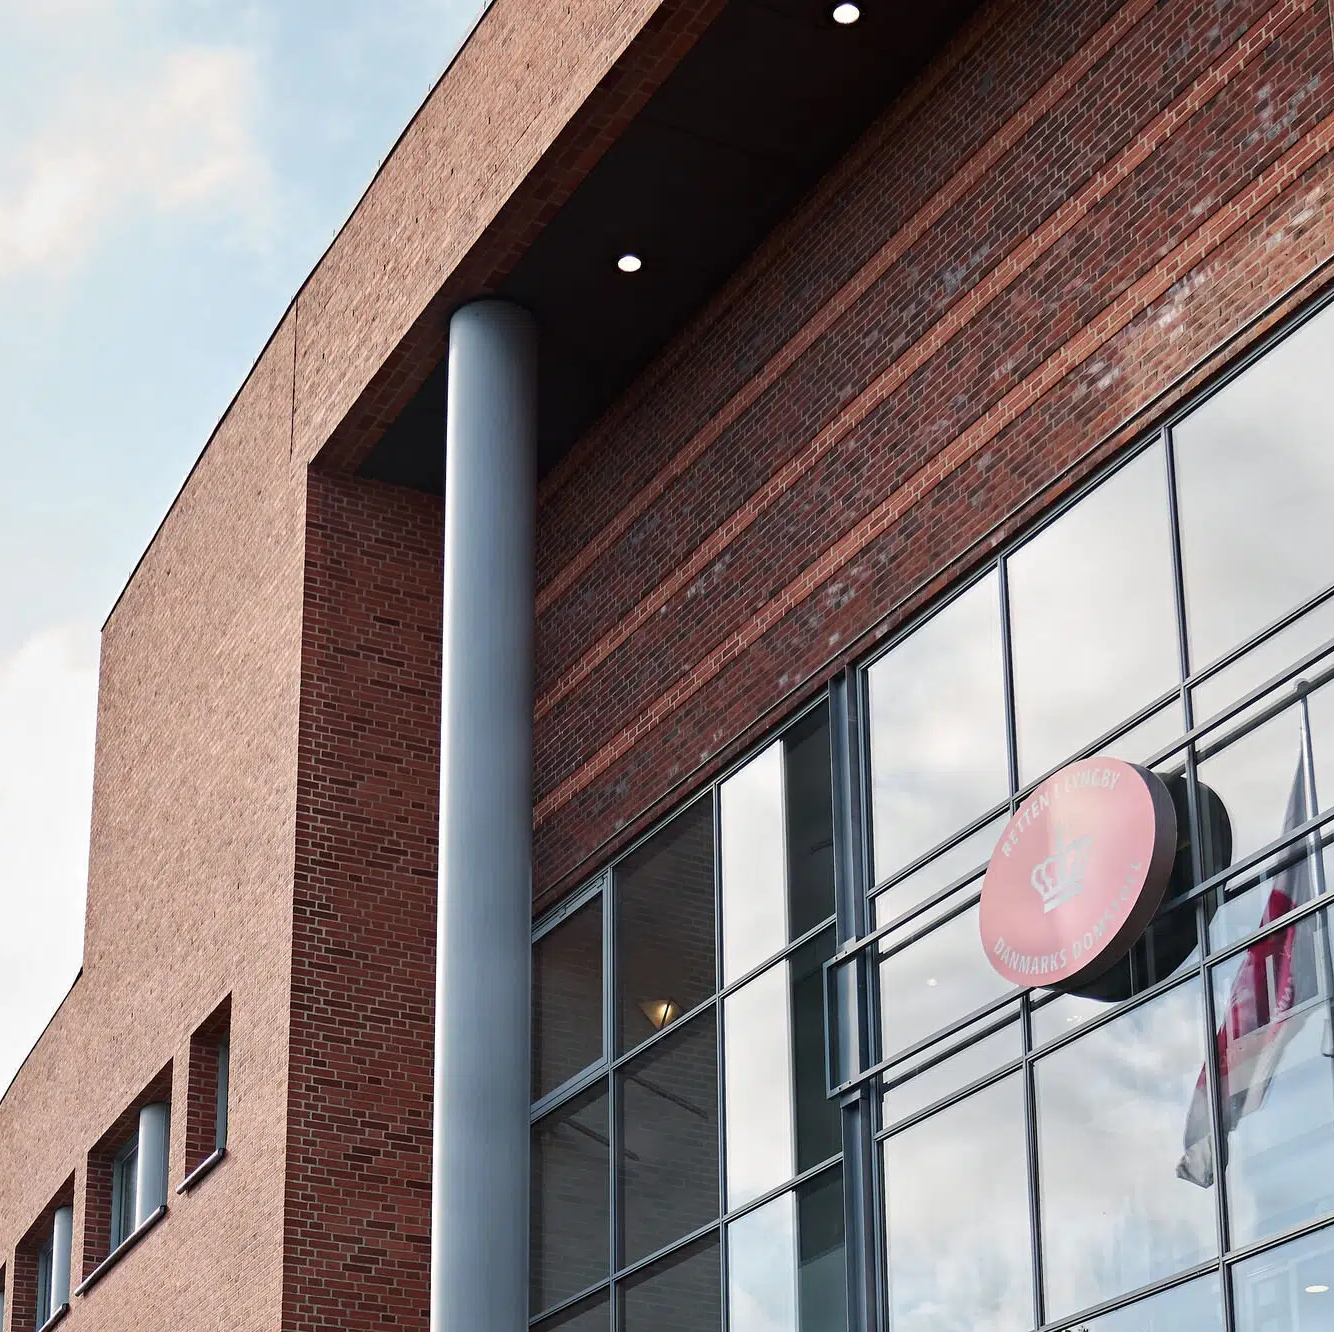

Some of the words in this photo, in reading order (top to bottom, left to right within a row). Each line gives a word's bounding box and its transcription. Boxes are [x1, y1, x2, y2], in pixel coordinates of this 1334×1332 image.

[1001, 791, 1052, 857] RETTEN
[1064, 767, 1121, 793] LYNGBY
[994, 936, 1067, 975] DANMARKS
[1072, 861, 1144, 959] DOMSTOLE
